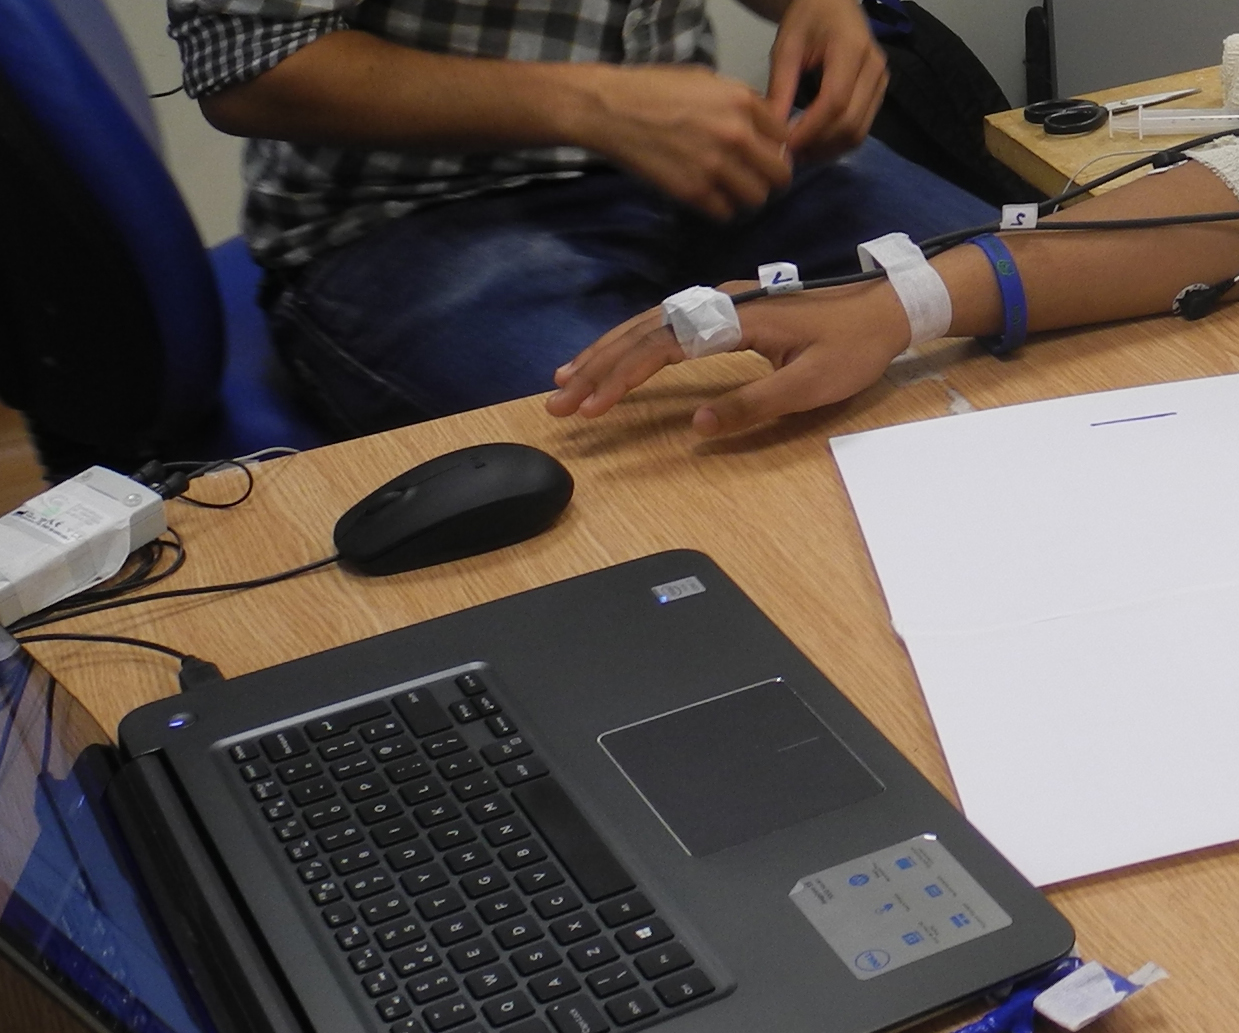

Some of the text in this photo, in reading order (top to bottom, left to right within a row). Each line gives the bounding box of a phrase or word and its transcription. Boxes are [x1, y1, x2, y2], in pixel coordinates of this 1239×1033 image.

[359, 783, 372, 791] P
[330, 805, 341, 813] 0
[374, 804, 387, 813] O
[431, 806, 444, 815] K
[483, 802, 498, 812] M
[344, 828, 356, 836] 9
[499, 825, 514, 835] N
[358, 850, 370, 859] 8
[403, 849, 416, 859] U
[461, 851, 475, 862] H
[516, 848, 530, 857] B
[418, 874, 430, 882] Y
[478, 876, 491, 885] G
[533, 873, 546, 882] V
[387, 899, 399, 907] 6
[433, 898, 446, 907] T
[550, 896, 564, 905] C
[403, 924, 416, 933] 5
[450, 922, 463, 932] R
[568, 920, 582, 932] X
[512, 926, 526, 936] D
[466, 948, 481, 958] E
[586, 946, 601, 957] Z
[529, 952, 543, 961] S
[436, 976, 448, 985] 3
[482, 973, 498, 986] W
[548, 977, 561, 987] A
[452, 1003, 465, 1012] 2
[500, 1000, 514, 1012] Q
